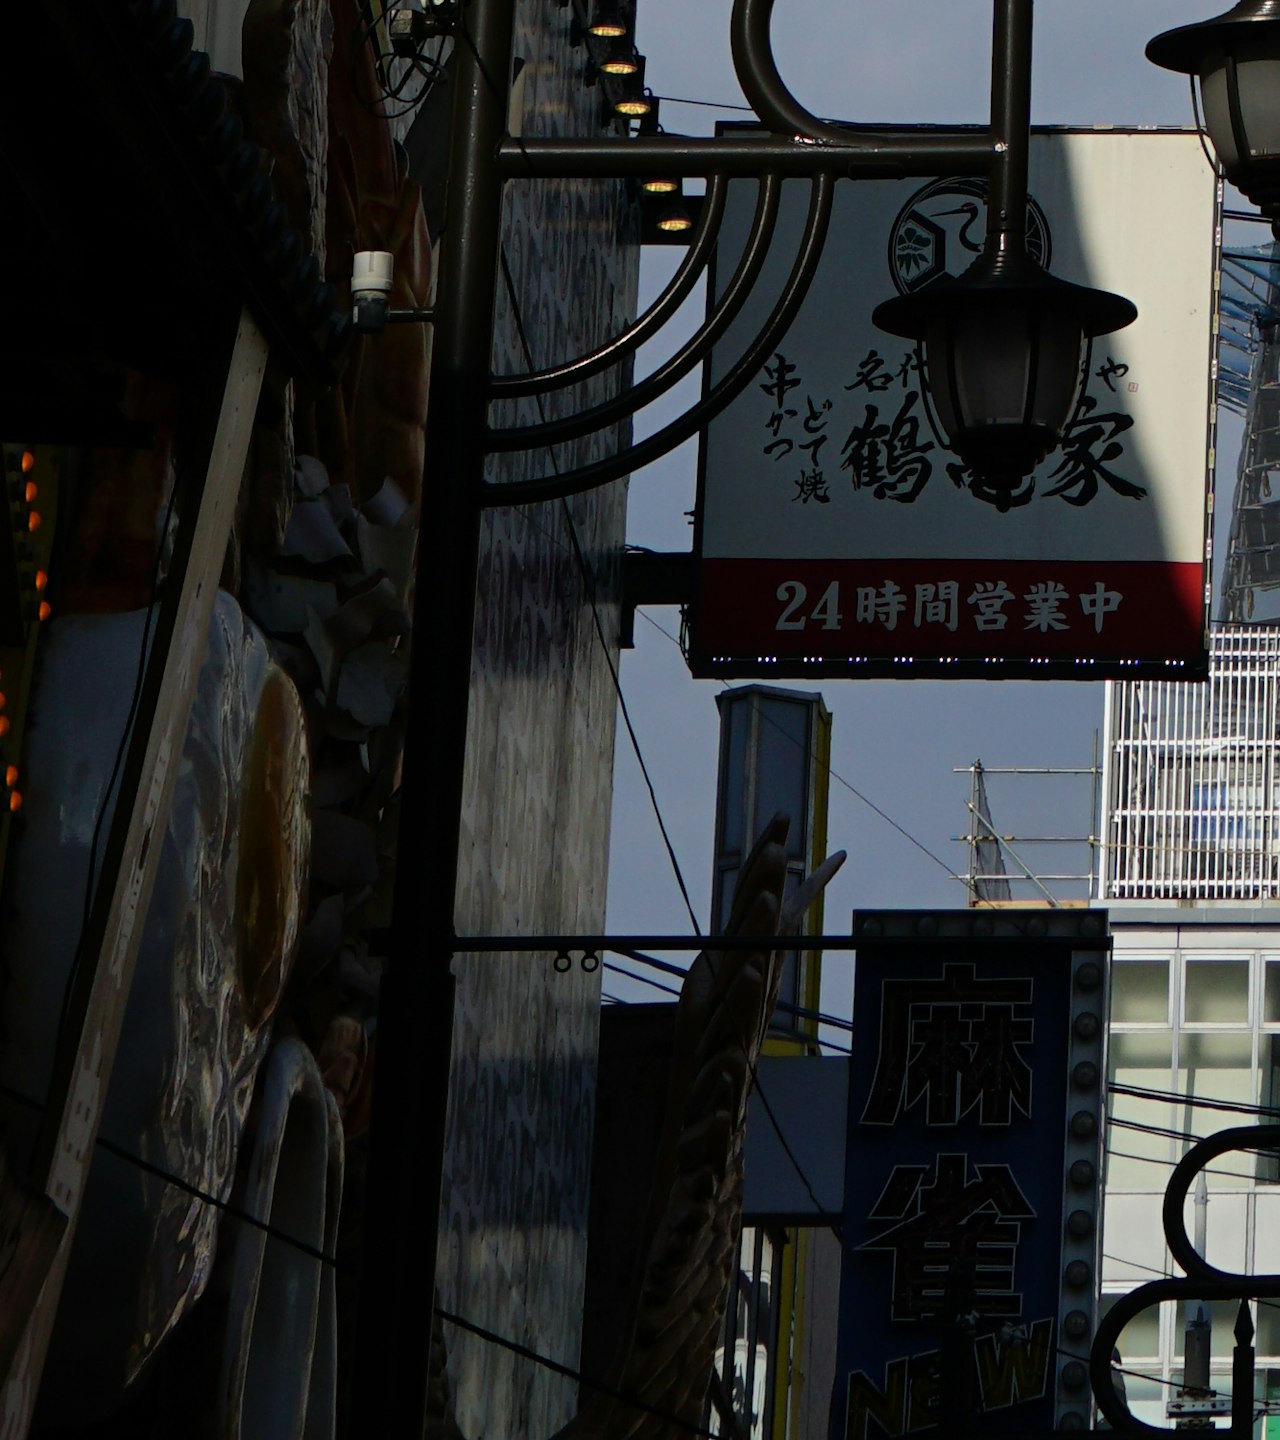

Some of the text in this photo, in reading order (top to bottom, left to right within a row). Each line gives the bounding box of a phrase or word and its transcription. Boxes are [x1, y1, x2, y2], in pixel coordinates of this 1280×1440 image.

[759, 353, 802, 462] 串かつ
[775, 580, 1124, 635] 24時間営業中
[854, 962, 1038, 1323] 麻雀
